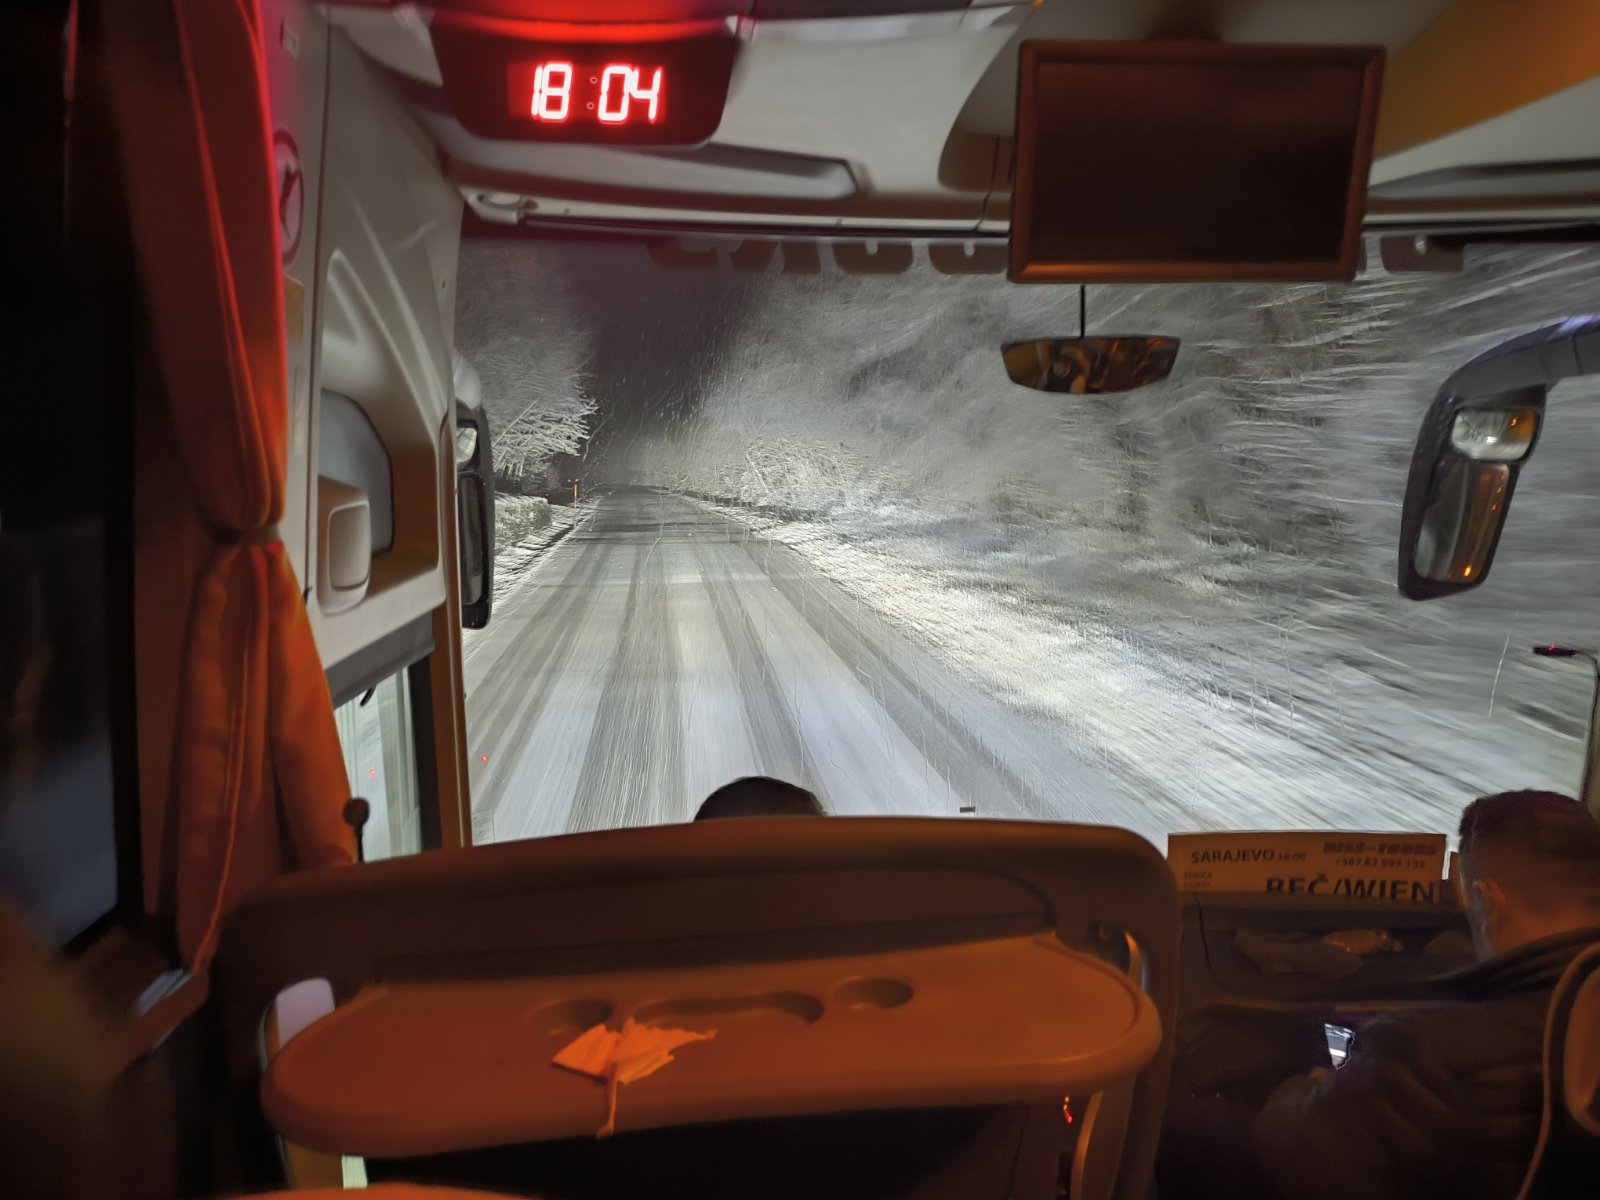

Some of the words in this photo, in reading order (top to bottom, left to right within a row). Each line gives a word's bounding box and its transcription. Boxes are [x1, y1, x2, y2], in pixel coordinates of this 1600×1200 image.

[531, 61, 663, 122] 18:04
[1191, 849, 1275, 864] SARAJEVO
[1278, 852, 1306, 862] 18:00
